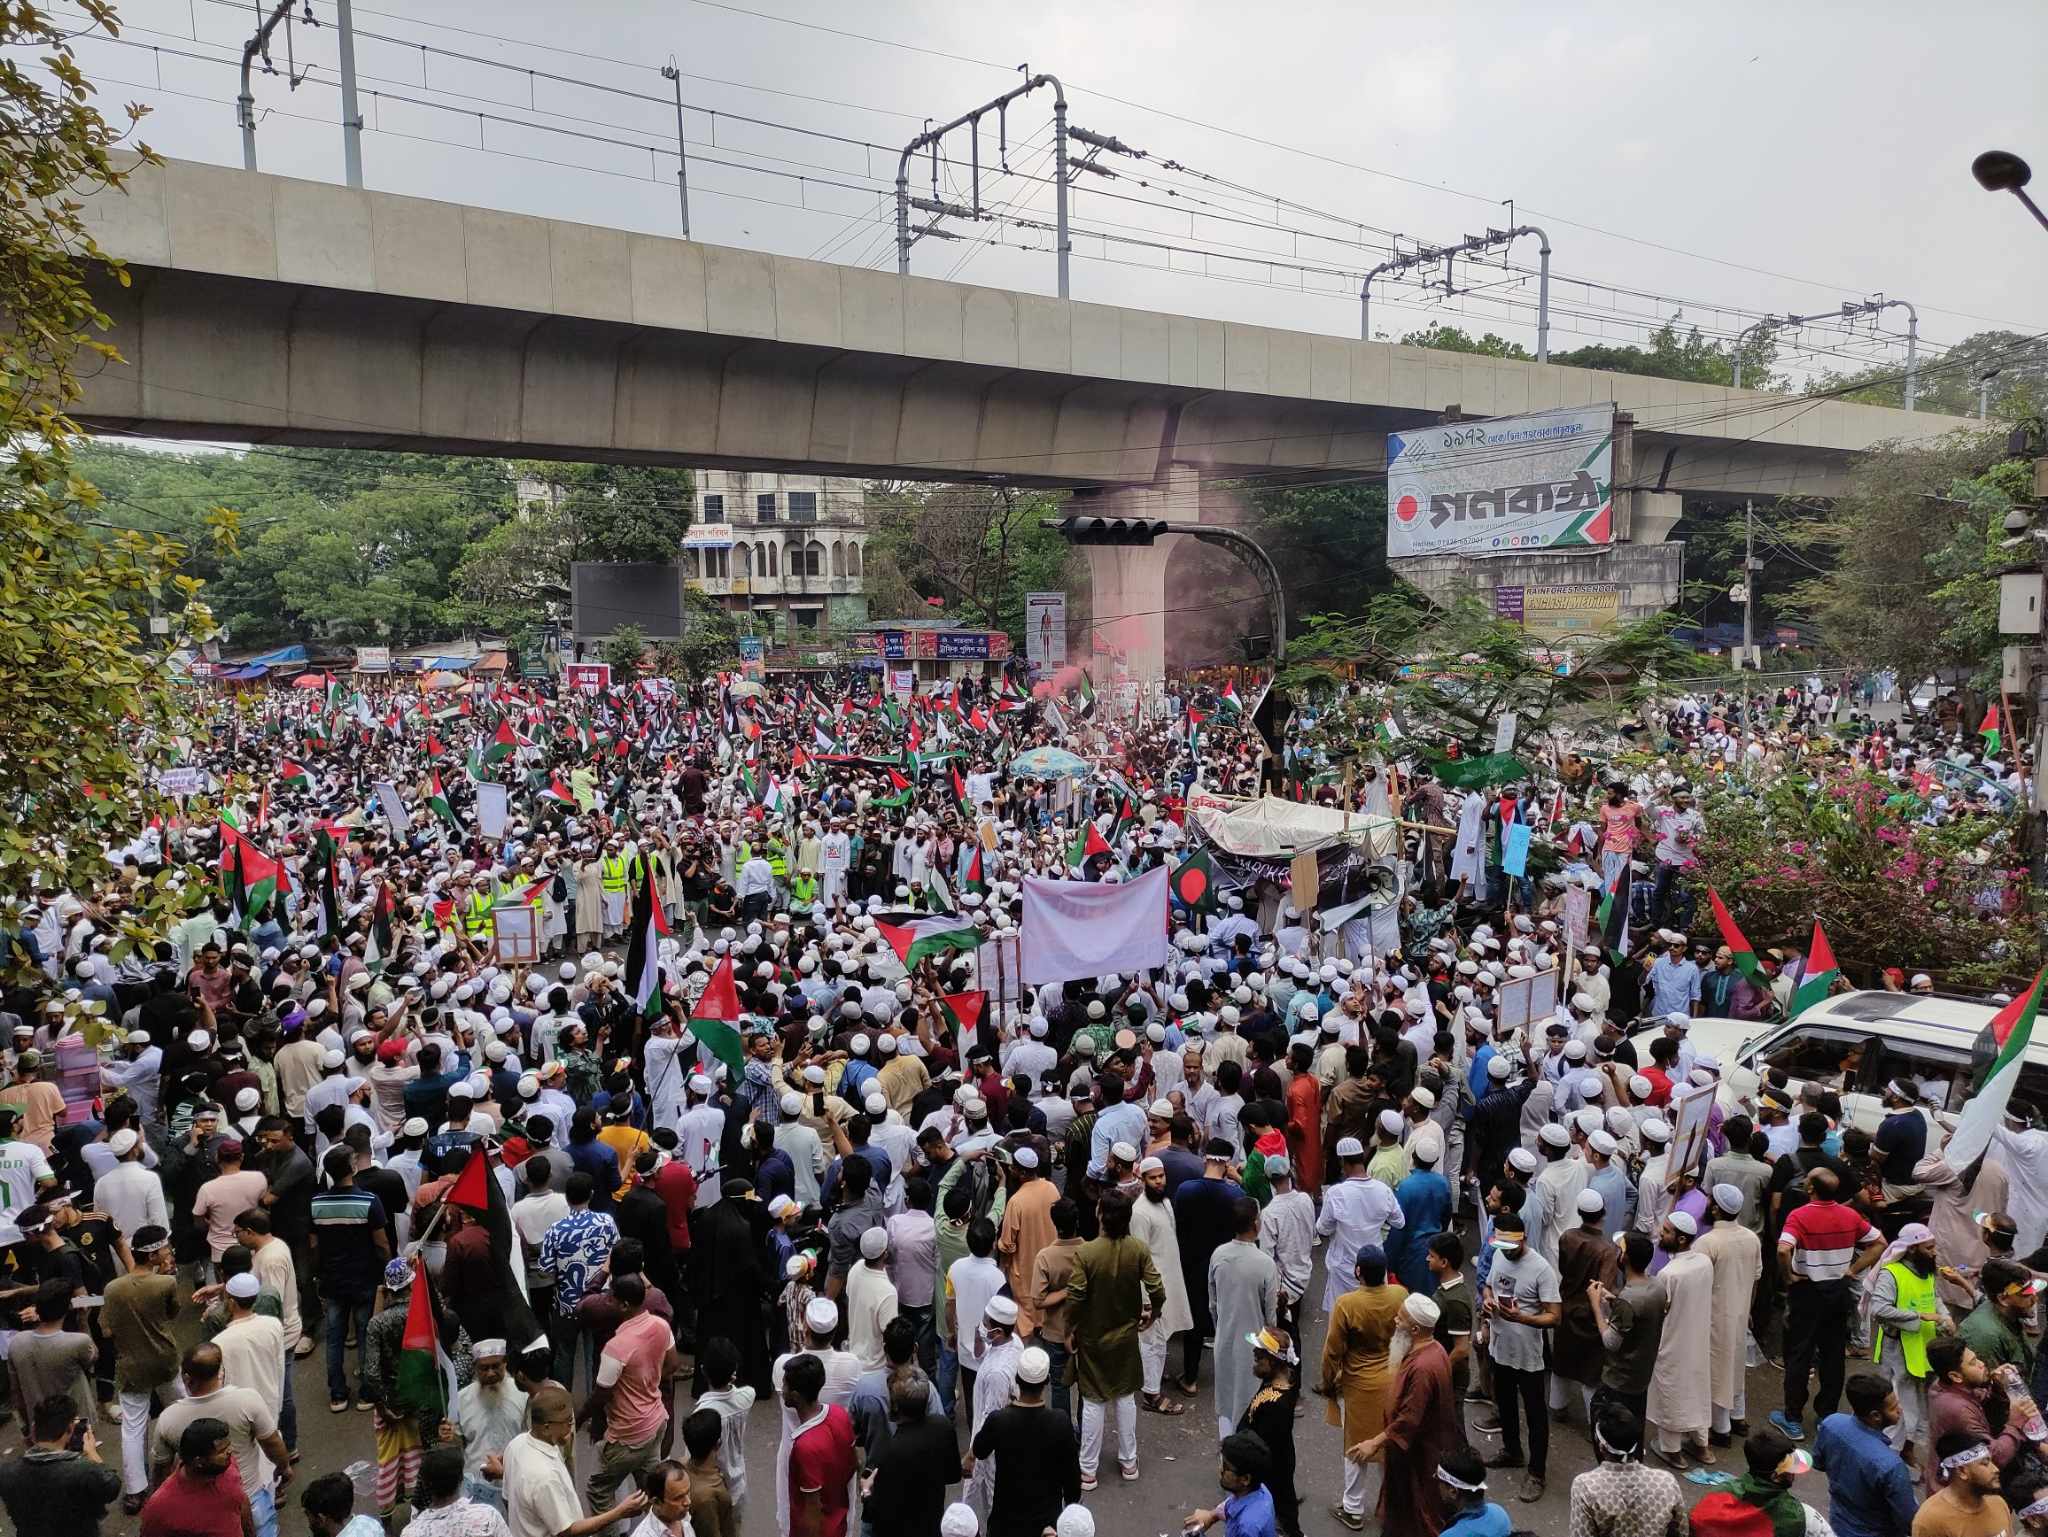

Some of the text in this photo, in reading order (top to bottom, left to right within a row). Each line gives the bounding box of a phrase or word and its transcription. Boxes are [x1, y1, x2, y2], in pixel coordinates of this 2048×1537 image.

[1443, 427, 1486, 448] ১৯৭২
[1526, 583, 1617, 595] RAINFOREST SCHOOL
[960, 644, 975, 655] পুলিশ
